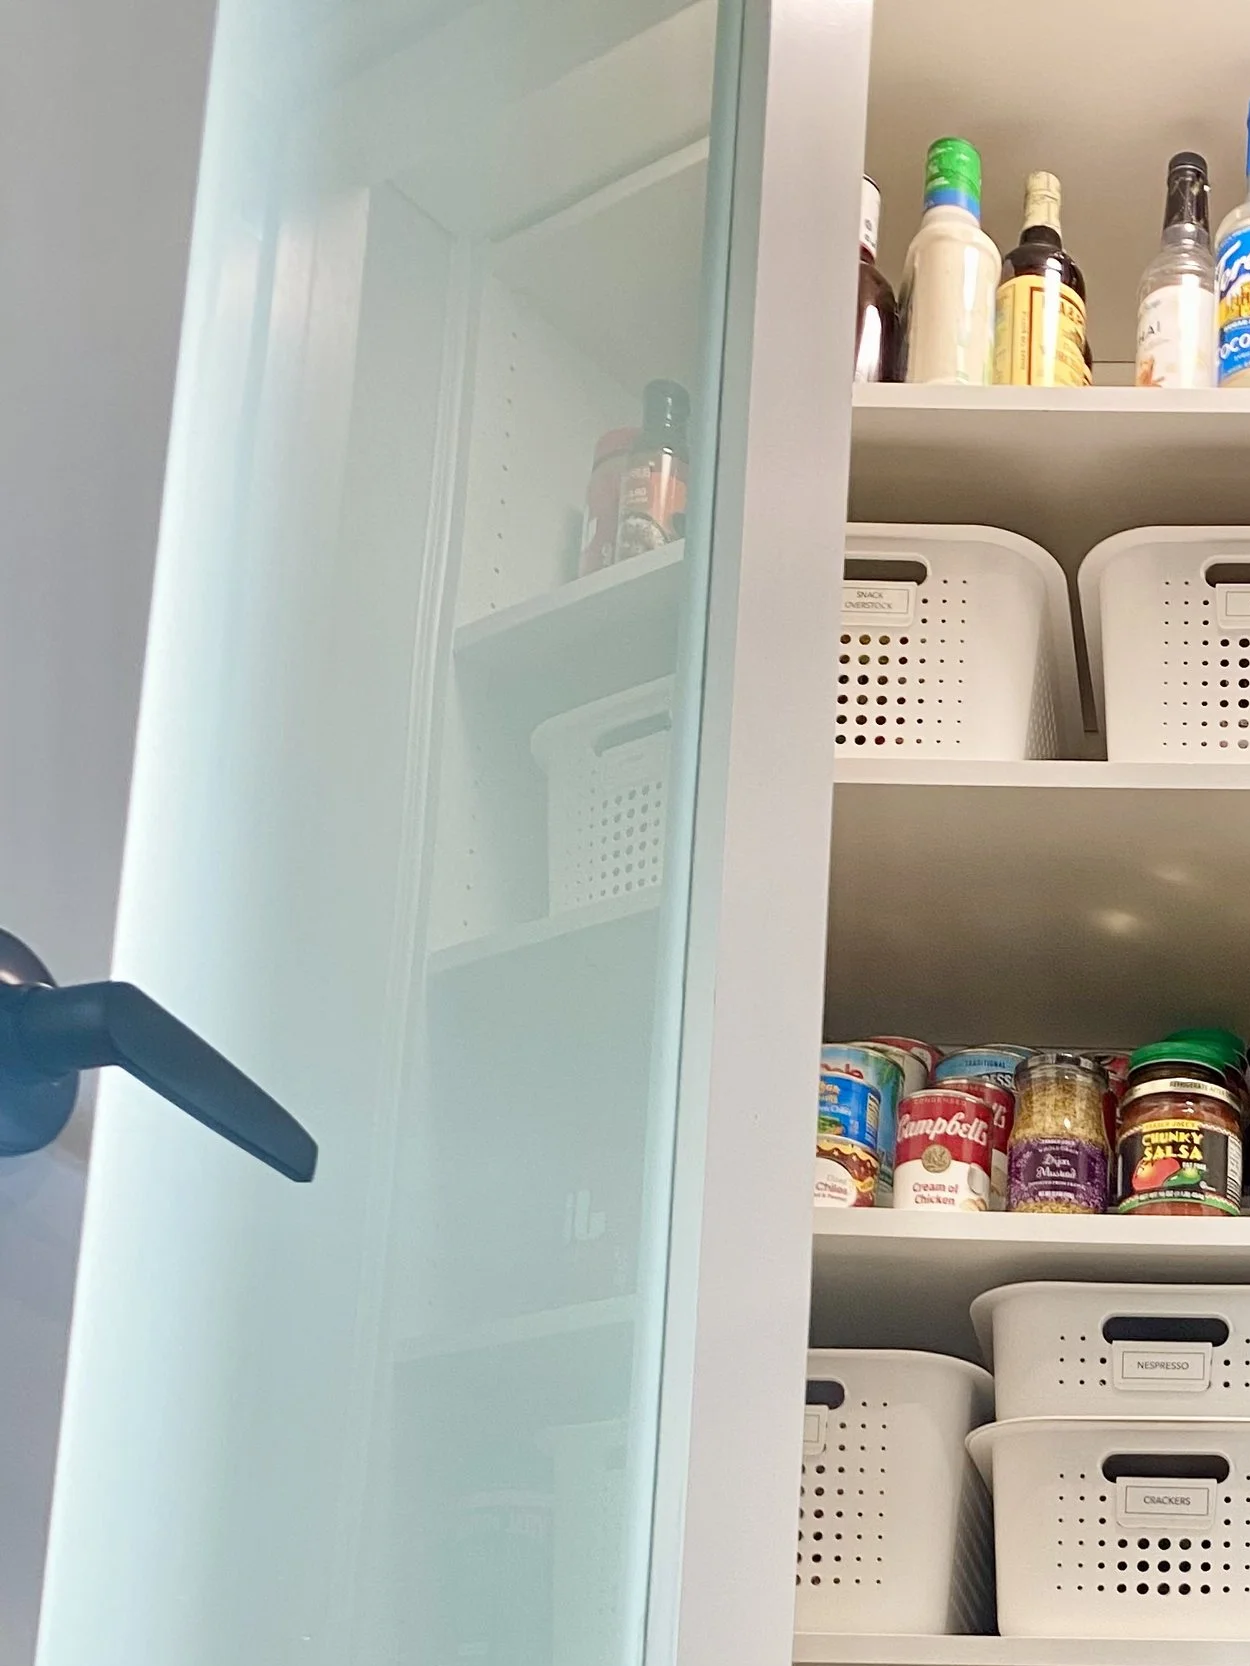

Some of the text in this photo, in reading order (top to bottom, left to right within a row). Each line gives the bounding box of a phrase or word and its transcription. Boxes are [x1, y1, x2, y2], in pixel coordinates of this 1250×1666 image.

[1142, 1131, 1204, 1147] CHUNKY
[1142, 1144, 1203, 1162] SALSA
[912, 1182, 946, 1193] Cream
[914, 1195, 955, 1204] Chicken
[1137, 1361, 1189, 1370] NESPRESSO
[1143, 1495, 1191, 1506] CRACKERS
